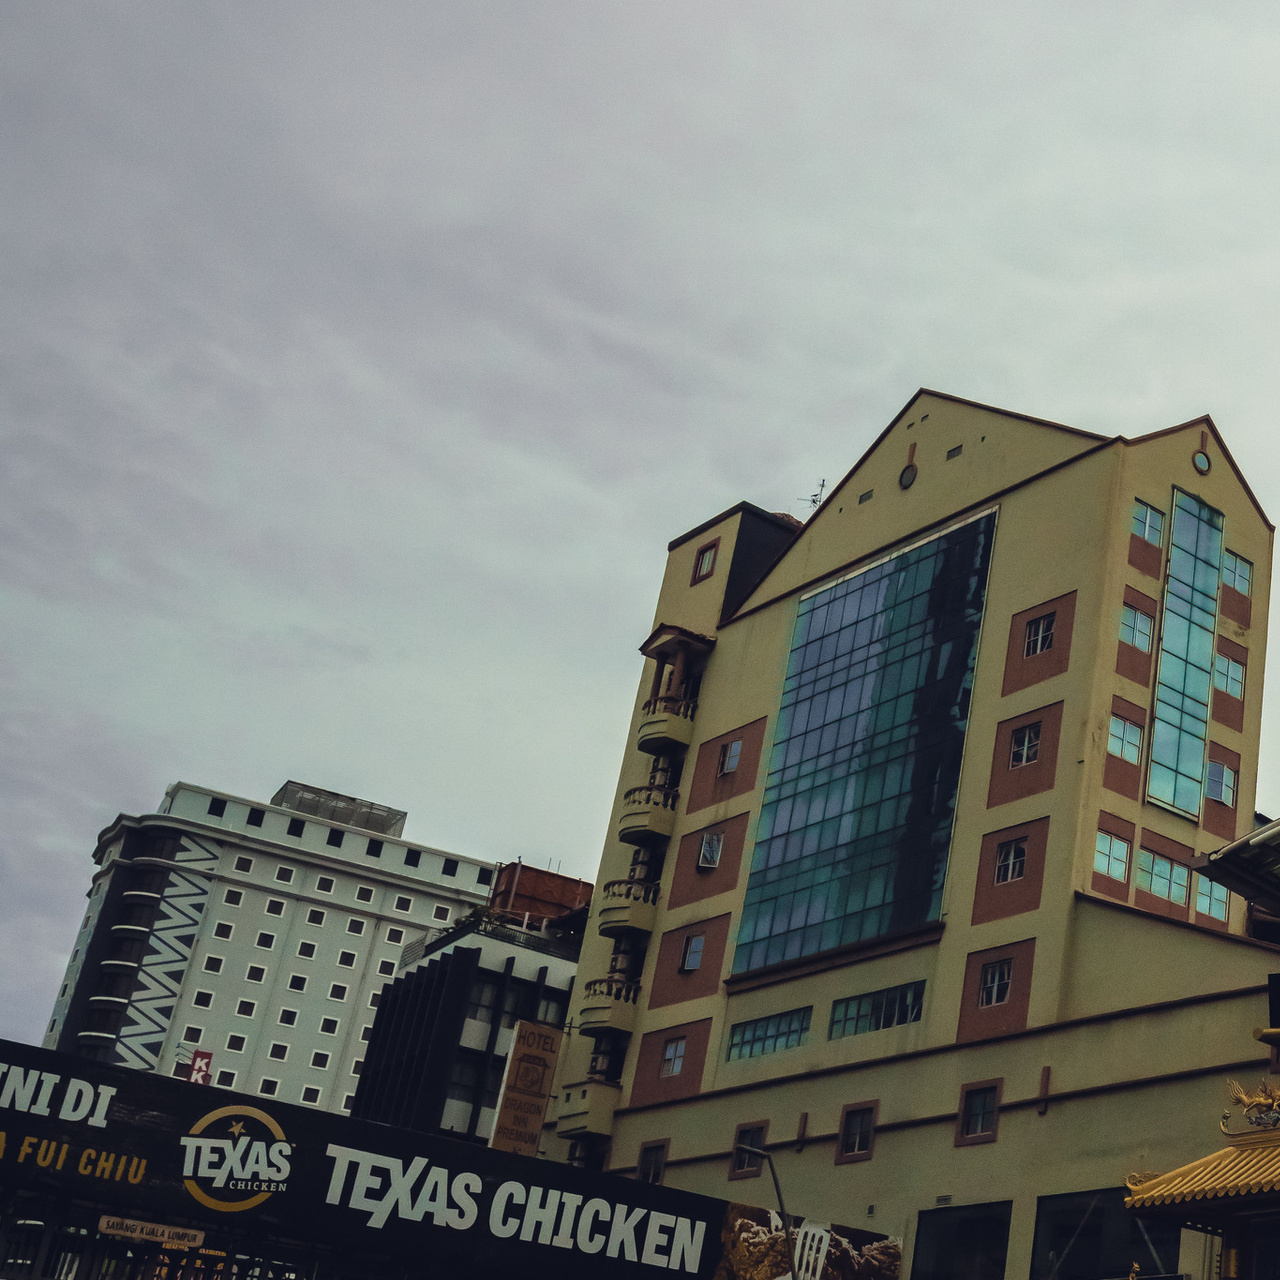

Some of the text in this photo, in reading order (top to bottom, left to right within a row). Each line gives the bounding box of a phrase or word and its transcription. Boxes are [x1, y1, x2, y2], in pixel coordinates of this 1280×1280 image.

[516, 1029, 557, 1054] HOTEL
[58, 1076, 118, 1129] DI
[503, 1097, 542, 1117] DRAGON
[497, 1127, 538, 1146] PREMIUM
[17, 1135, 69, 1171] FUI
[78, 1148, 148, 1185] CHIU
[180, 1135, 293, 1188] TEXAS
[229, 1180, 288, 1192] CHICKEN
[325, 1142, 707, 1274] TEXAS CHICKEN
[105, 1220, 198, 1244] SAYANGI KUALA LUMPUR
